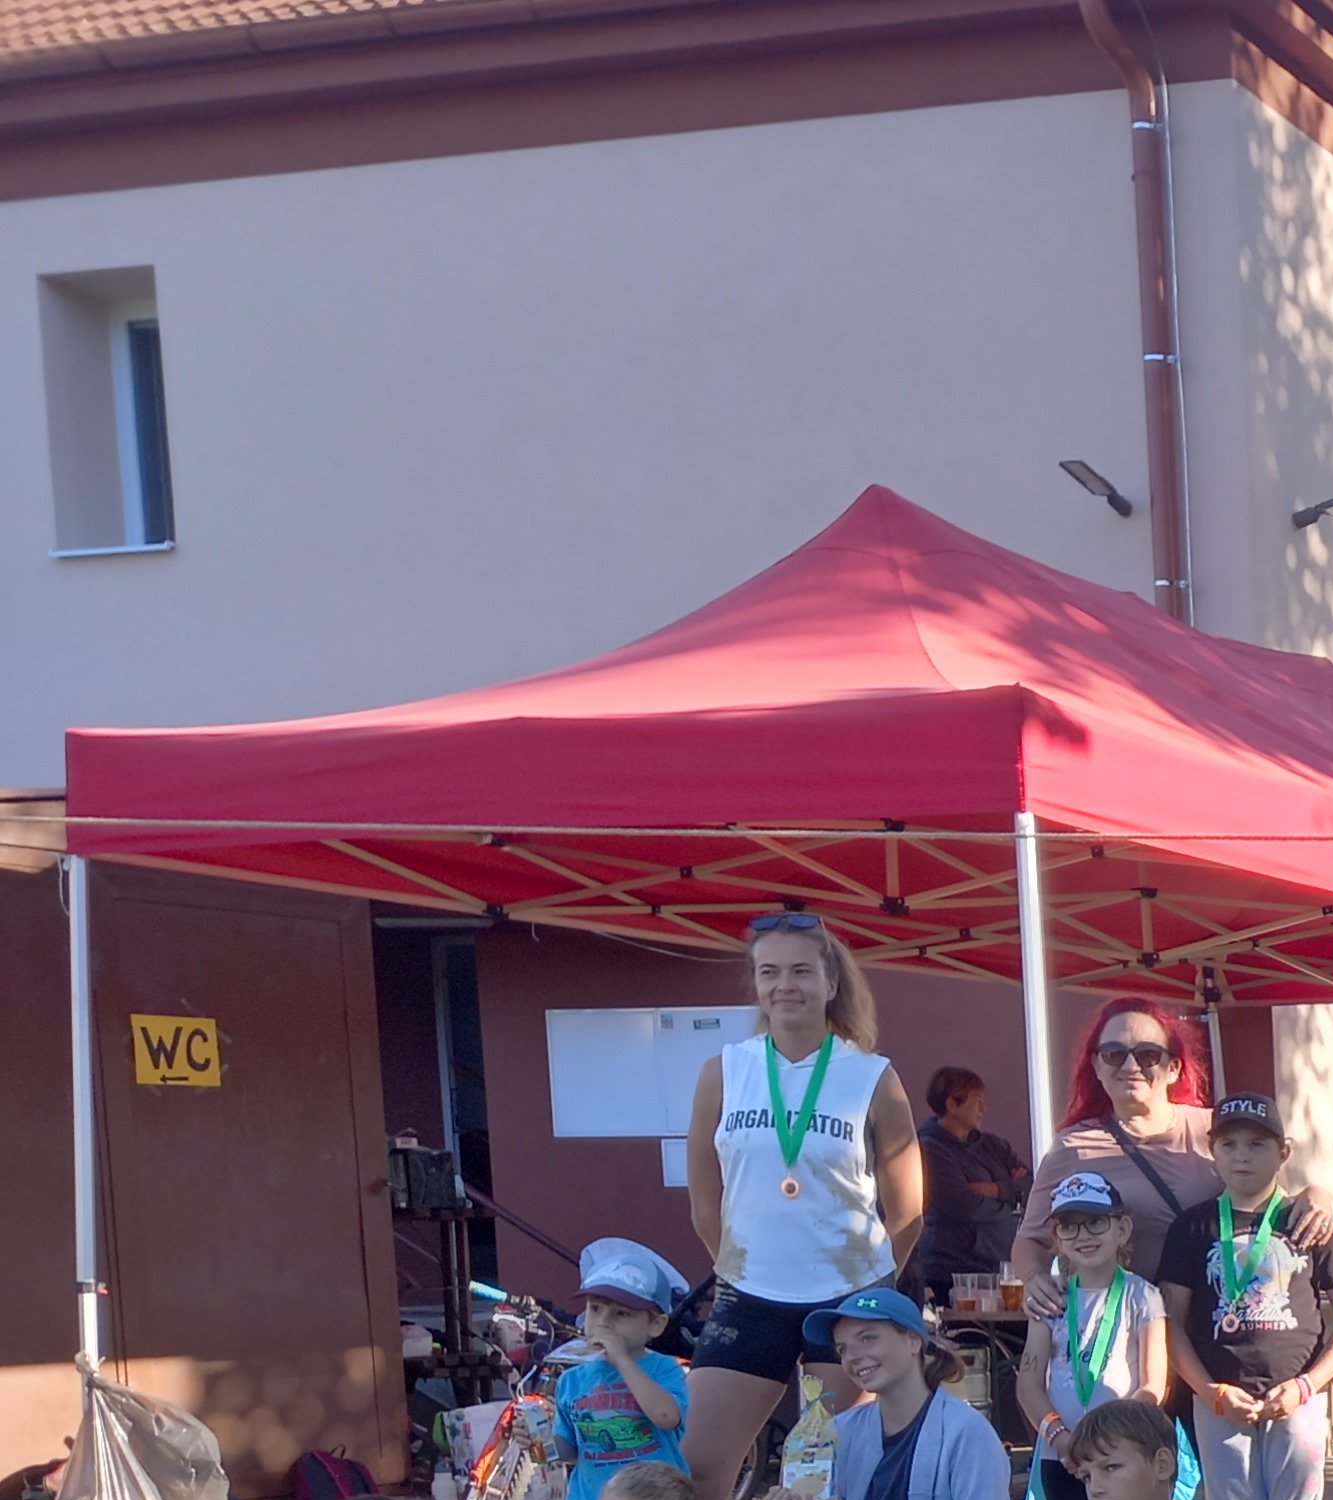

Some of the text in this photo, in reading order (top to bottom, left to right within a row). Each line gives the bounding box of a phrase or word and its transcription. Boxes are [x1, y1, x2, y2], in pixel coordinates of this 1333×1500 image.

[140, 1026, 212, 1072] WC
[1220, 1099, 1267, 1117] STYLE
[1240, 1320, 1287, 1331] SUMMER
